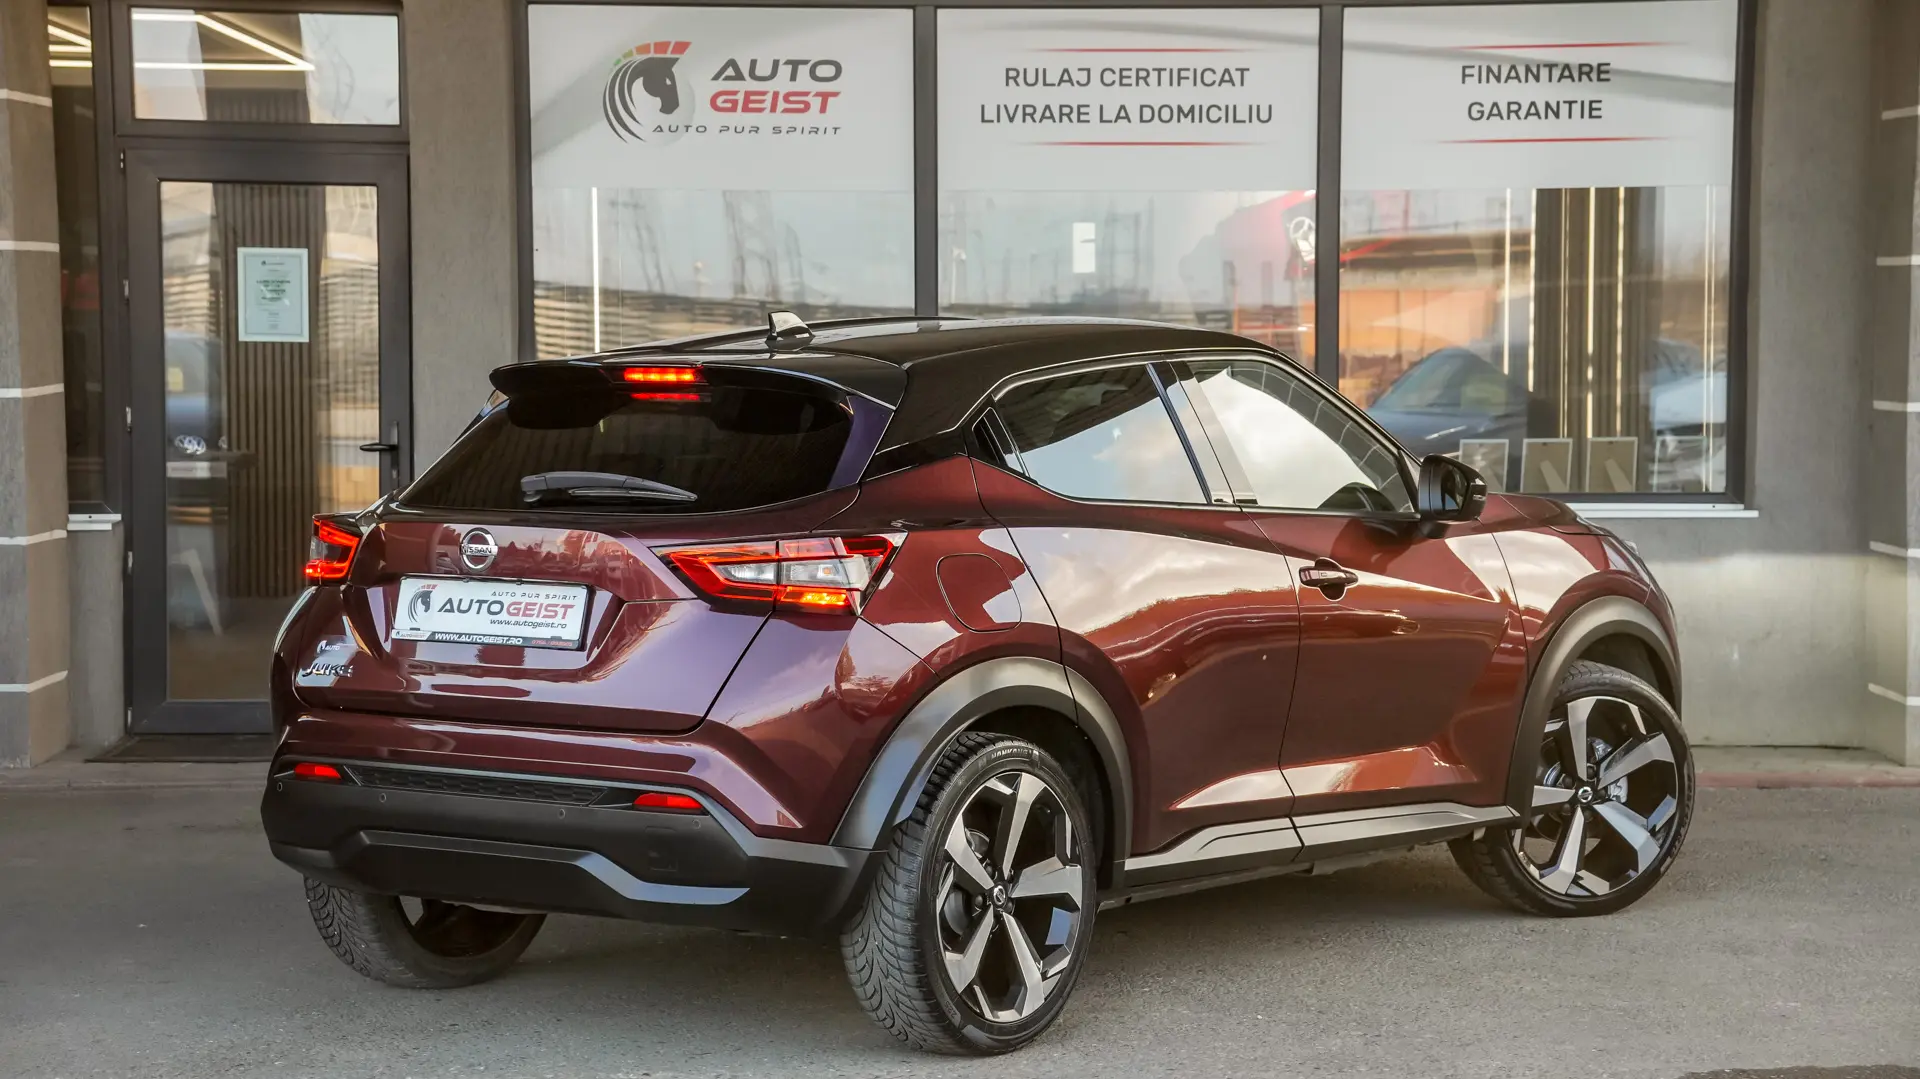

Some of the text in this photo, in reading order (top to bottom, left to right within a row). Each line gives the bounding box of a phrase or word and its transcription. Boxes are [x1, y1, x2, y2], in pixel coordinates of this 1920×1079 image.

[710, 58, 843, 82] AUTO
[1004, 67, 1250, 87] RULAJ CERTIFICAT
[1461, 63, 1611, 84] FINANTARE
[709, 90, 841, 114] GEIST
[1467, 100, 1603, 121] GARANTIE
[980, 104, 1273, 123] LIVRARE LA DOMICILIU
[652, 124, 842, 136] AUTO PUR SPIRIT
[462, 545, 492, 554] NISSAN
[520, 592, 541, 600] PUR
[544, 593, 578, 601] SPIRIT
[437, 598, 576, 619] AUTOGEIST
[489, 618, 567, 629] www.autogeist.ro
[435, 633, 523, 645] WWW.AUTOGEIST.RO
